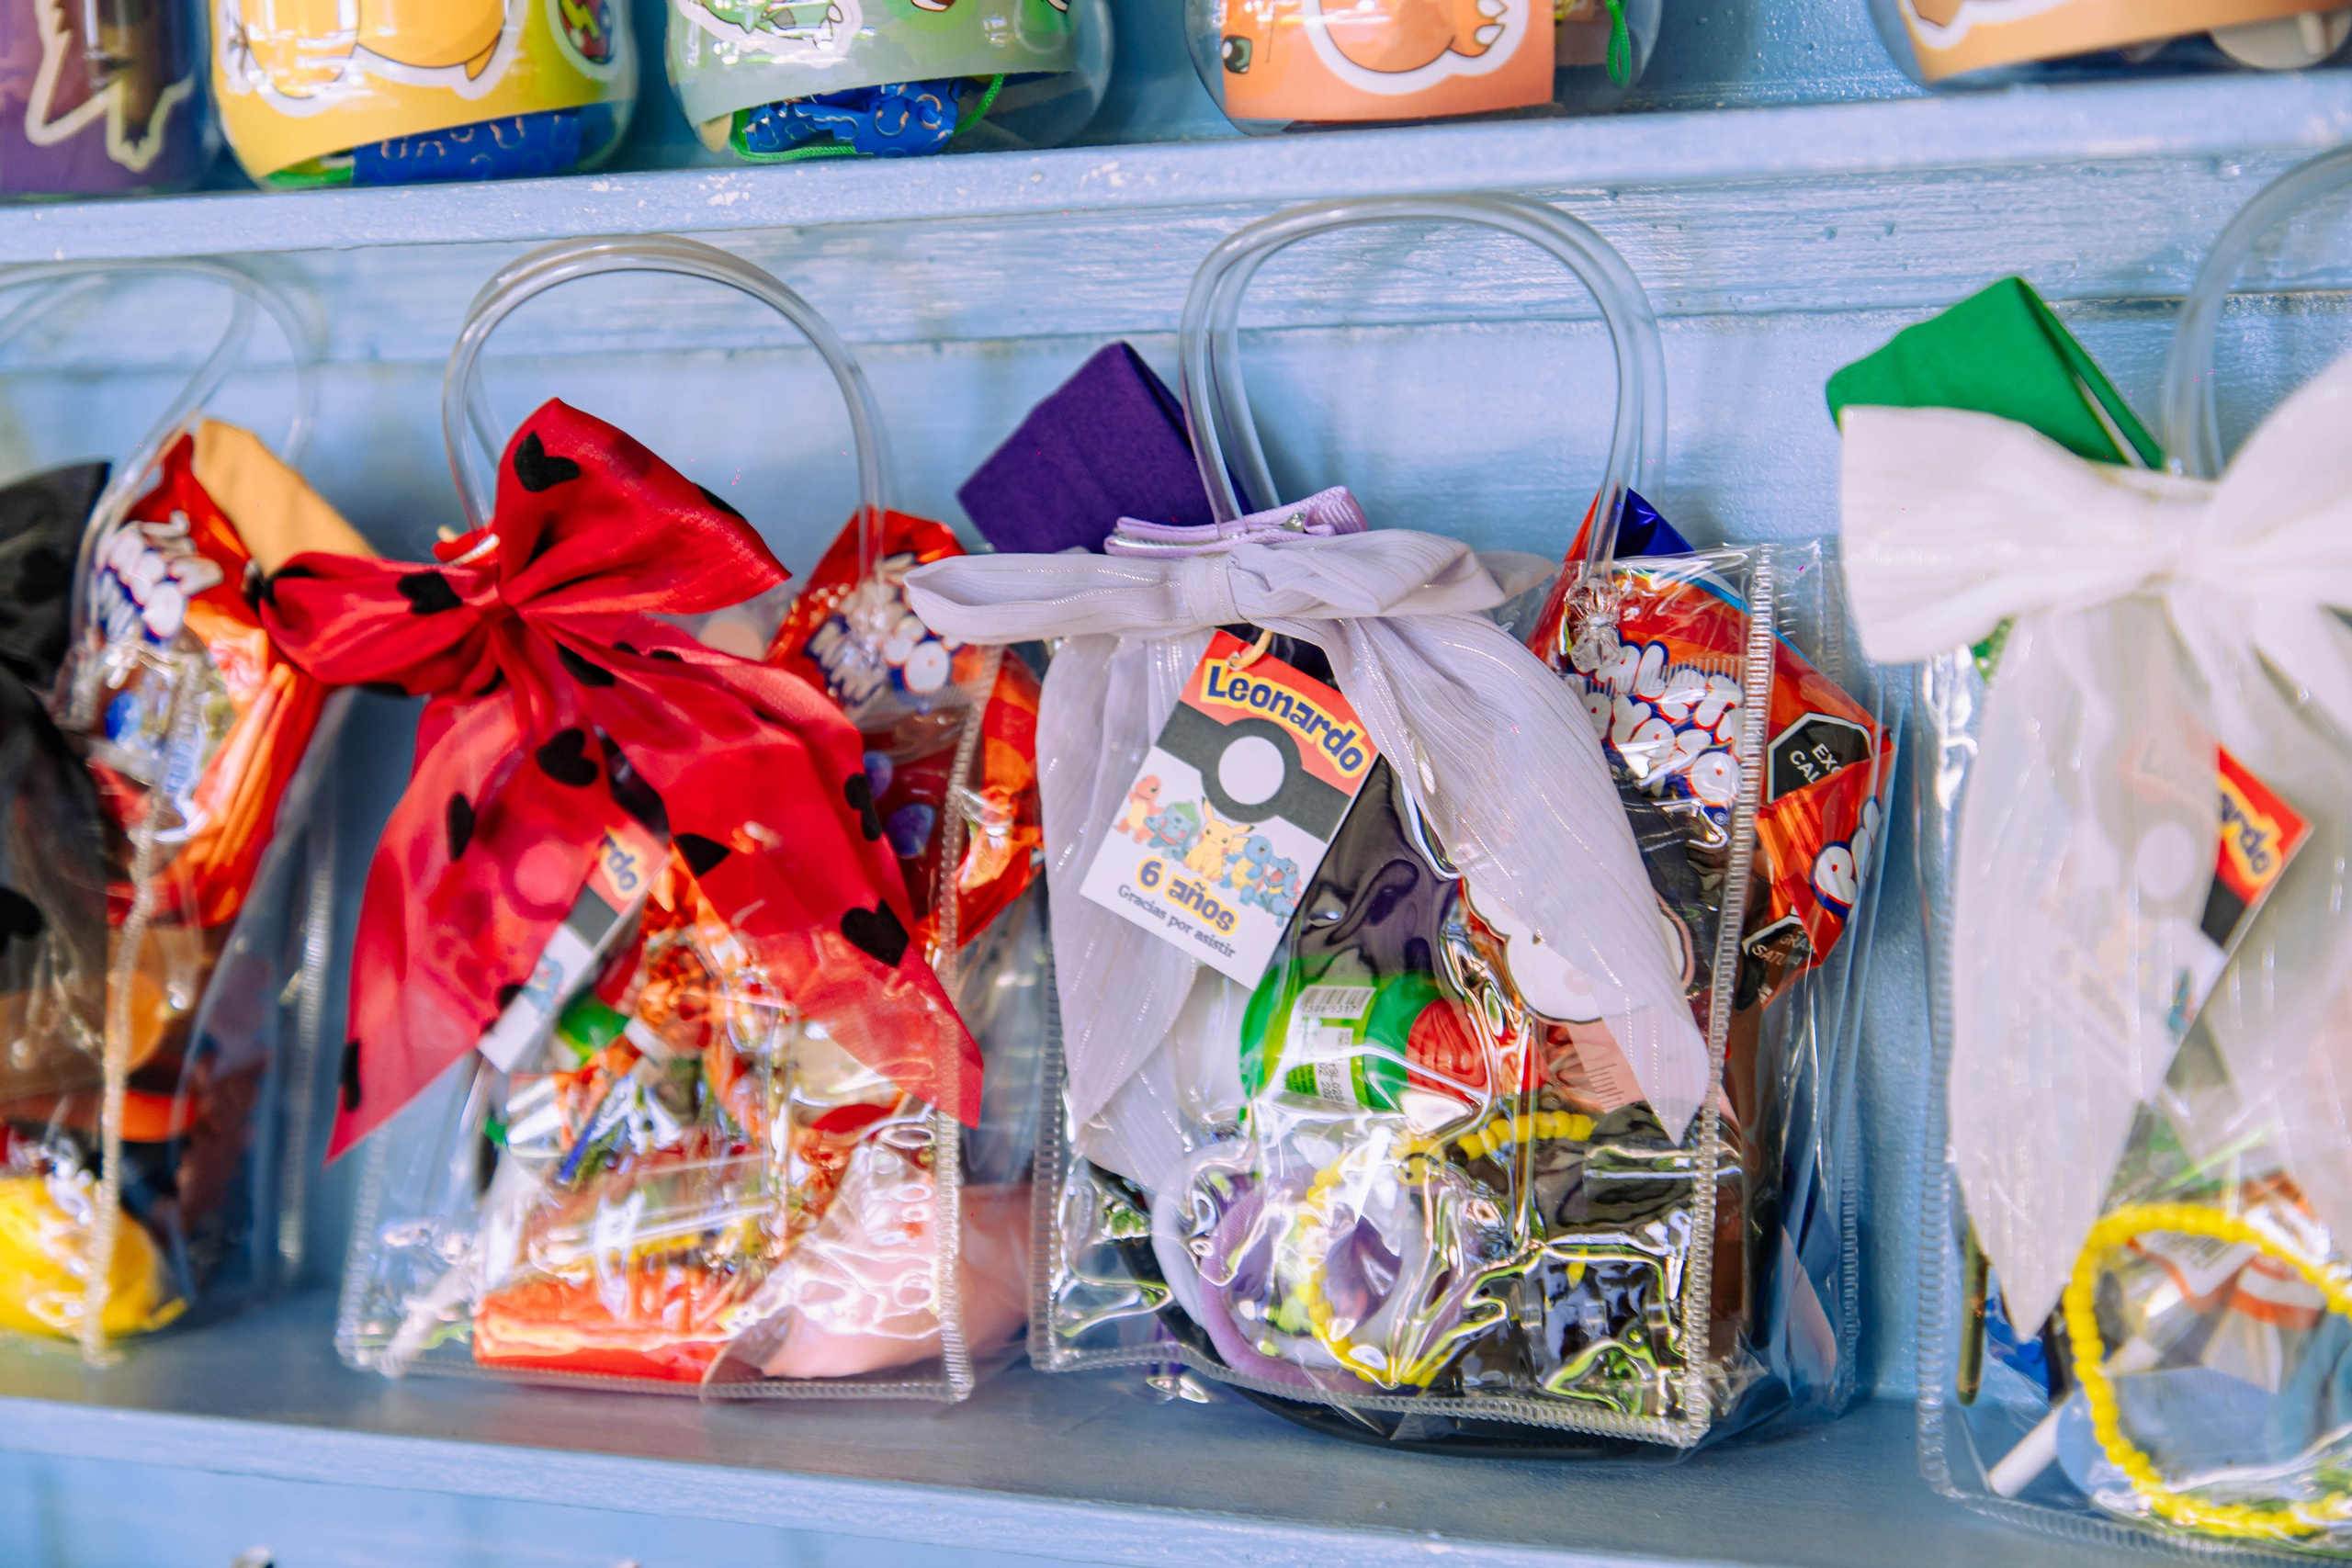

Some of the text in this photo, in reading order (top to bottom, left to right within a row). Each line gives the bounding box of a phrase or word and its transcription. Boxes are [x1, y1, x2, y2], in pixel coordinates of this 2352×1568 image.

[1205, 663, 1365, 773] Leonardo
[1117, 884, 1237, 959] Gracias por asistir
[1139, 860, 1236, 933] 6 años
